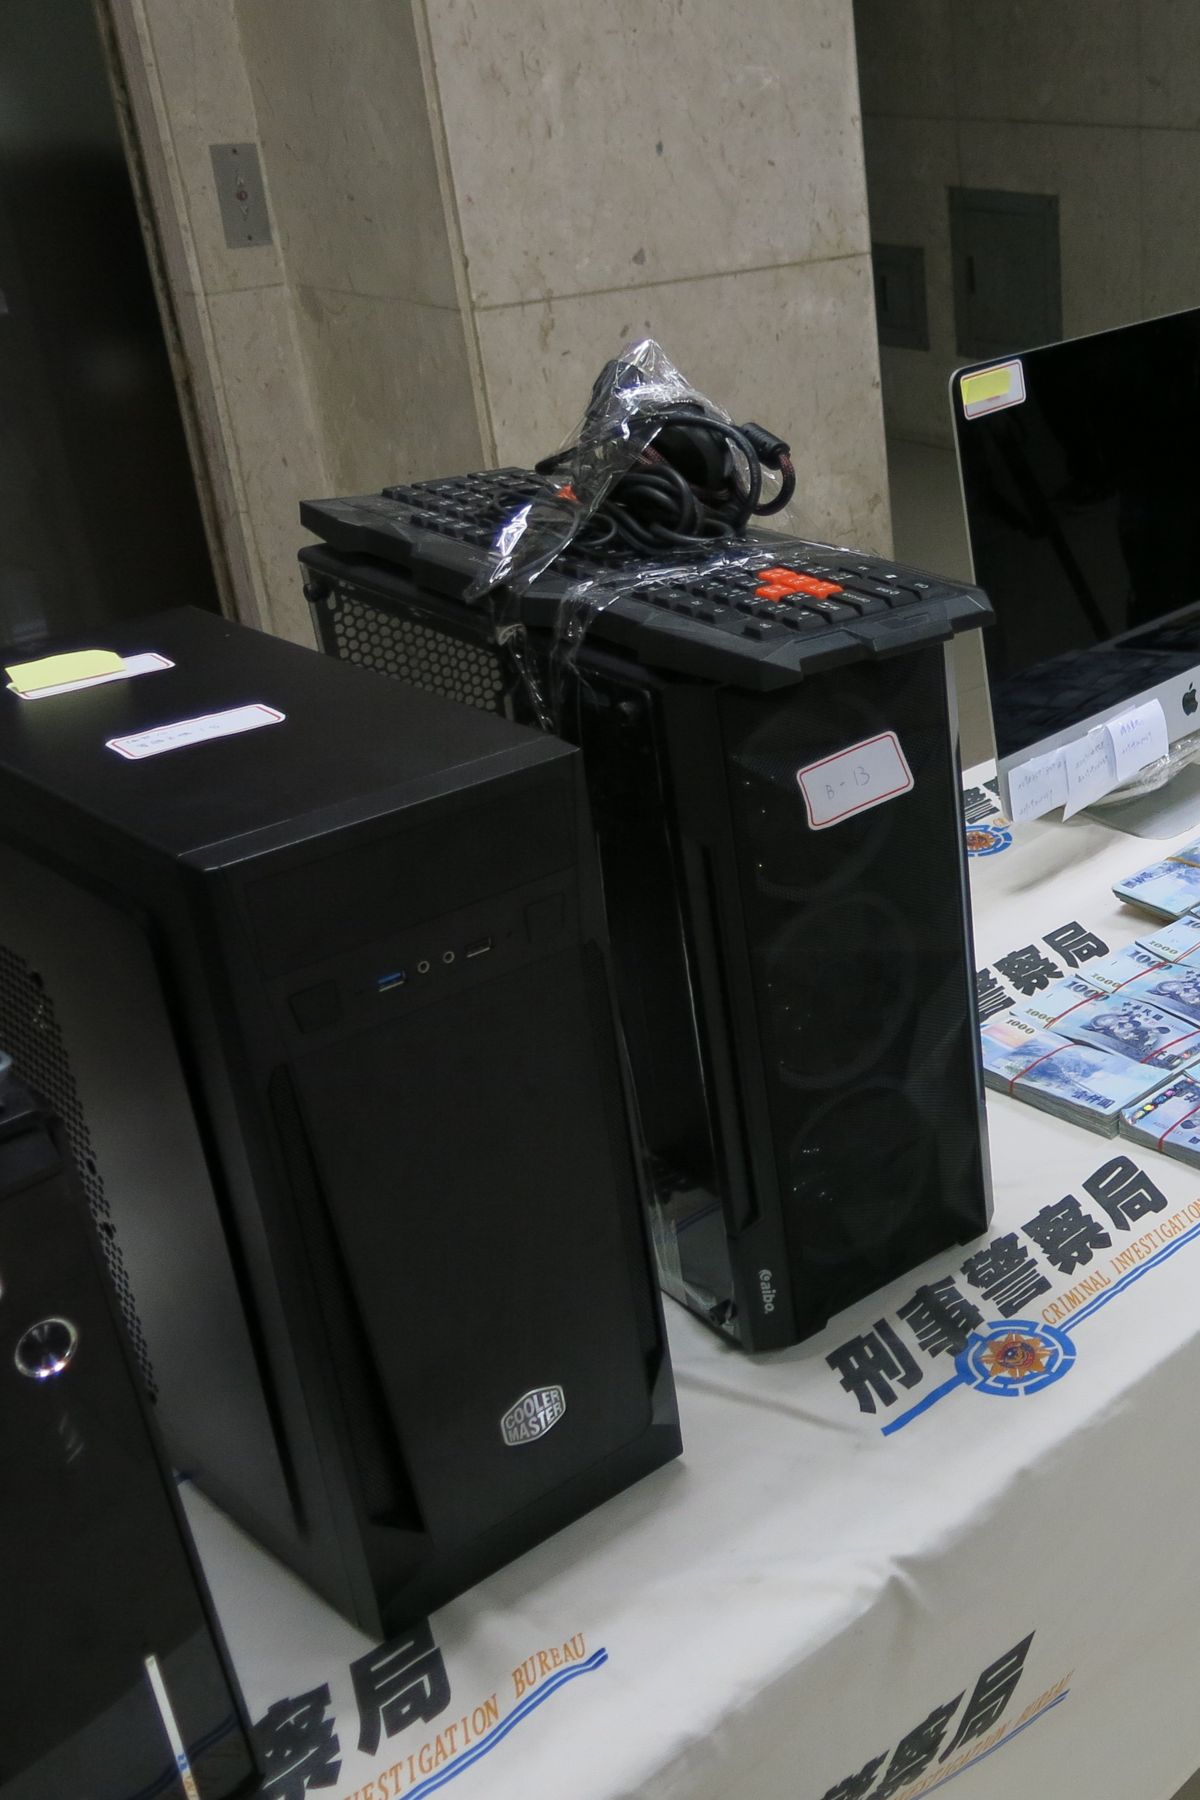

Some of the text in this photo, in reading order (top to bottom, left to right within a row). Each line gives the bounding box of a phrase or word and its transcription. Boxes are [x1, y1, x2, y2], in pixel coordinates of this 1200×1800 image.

[1005, 1018, 1036, 1035] 1000
[824, 1155, 1169, 1414] 刑事警察局
[1041, 1270, 1112, 1325] CRIMINAL
[505, 1390, 560, 1429] COOLER
[508, 1402, 563, 1442] MASTER
[511, 1632, 588, 1699] BUREAU
